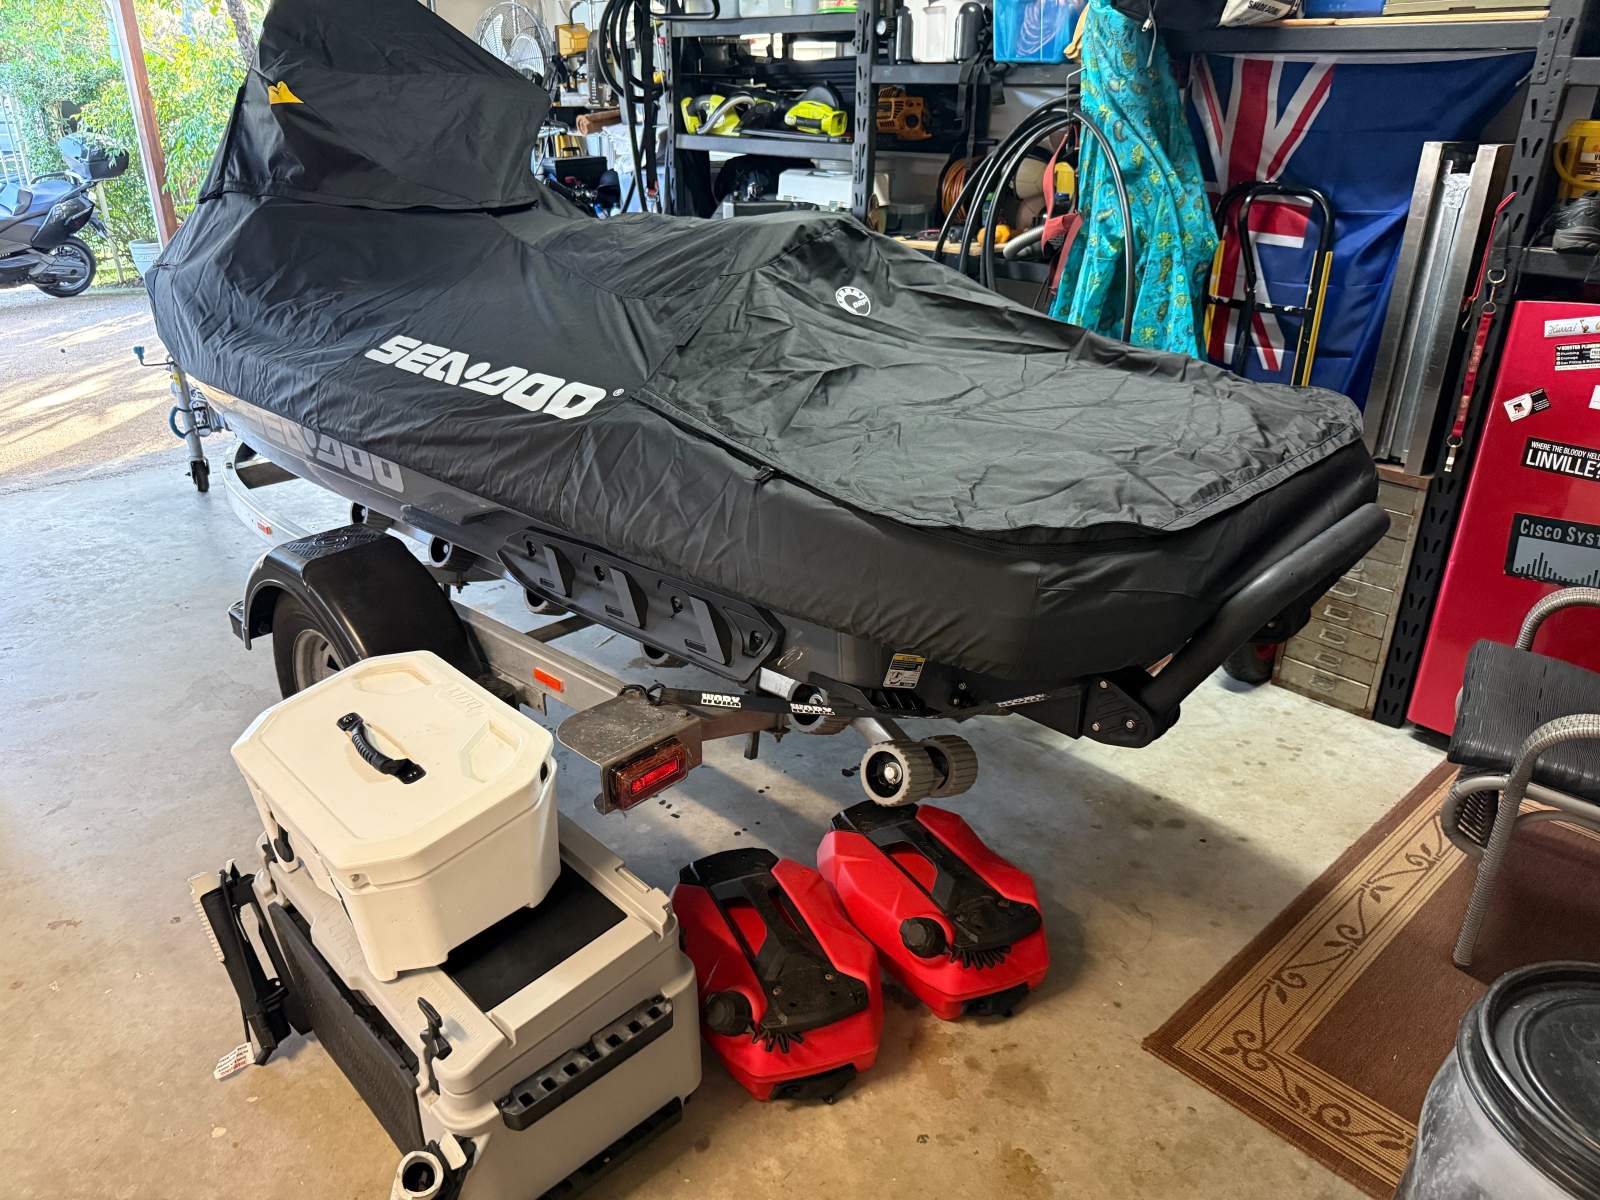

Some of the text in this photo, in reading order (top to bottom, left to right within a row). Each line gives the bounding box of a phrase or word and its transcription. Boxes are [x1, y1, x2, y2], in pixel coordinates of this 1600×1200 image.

[1531, 440, 1552, 451] WHERE
[1552, 445, 1563, 454] THE
[1563, 447, 1587, 458] BLOODY
